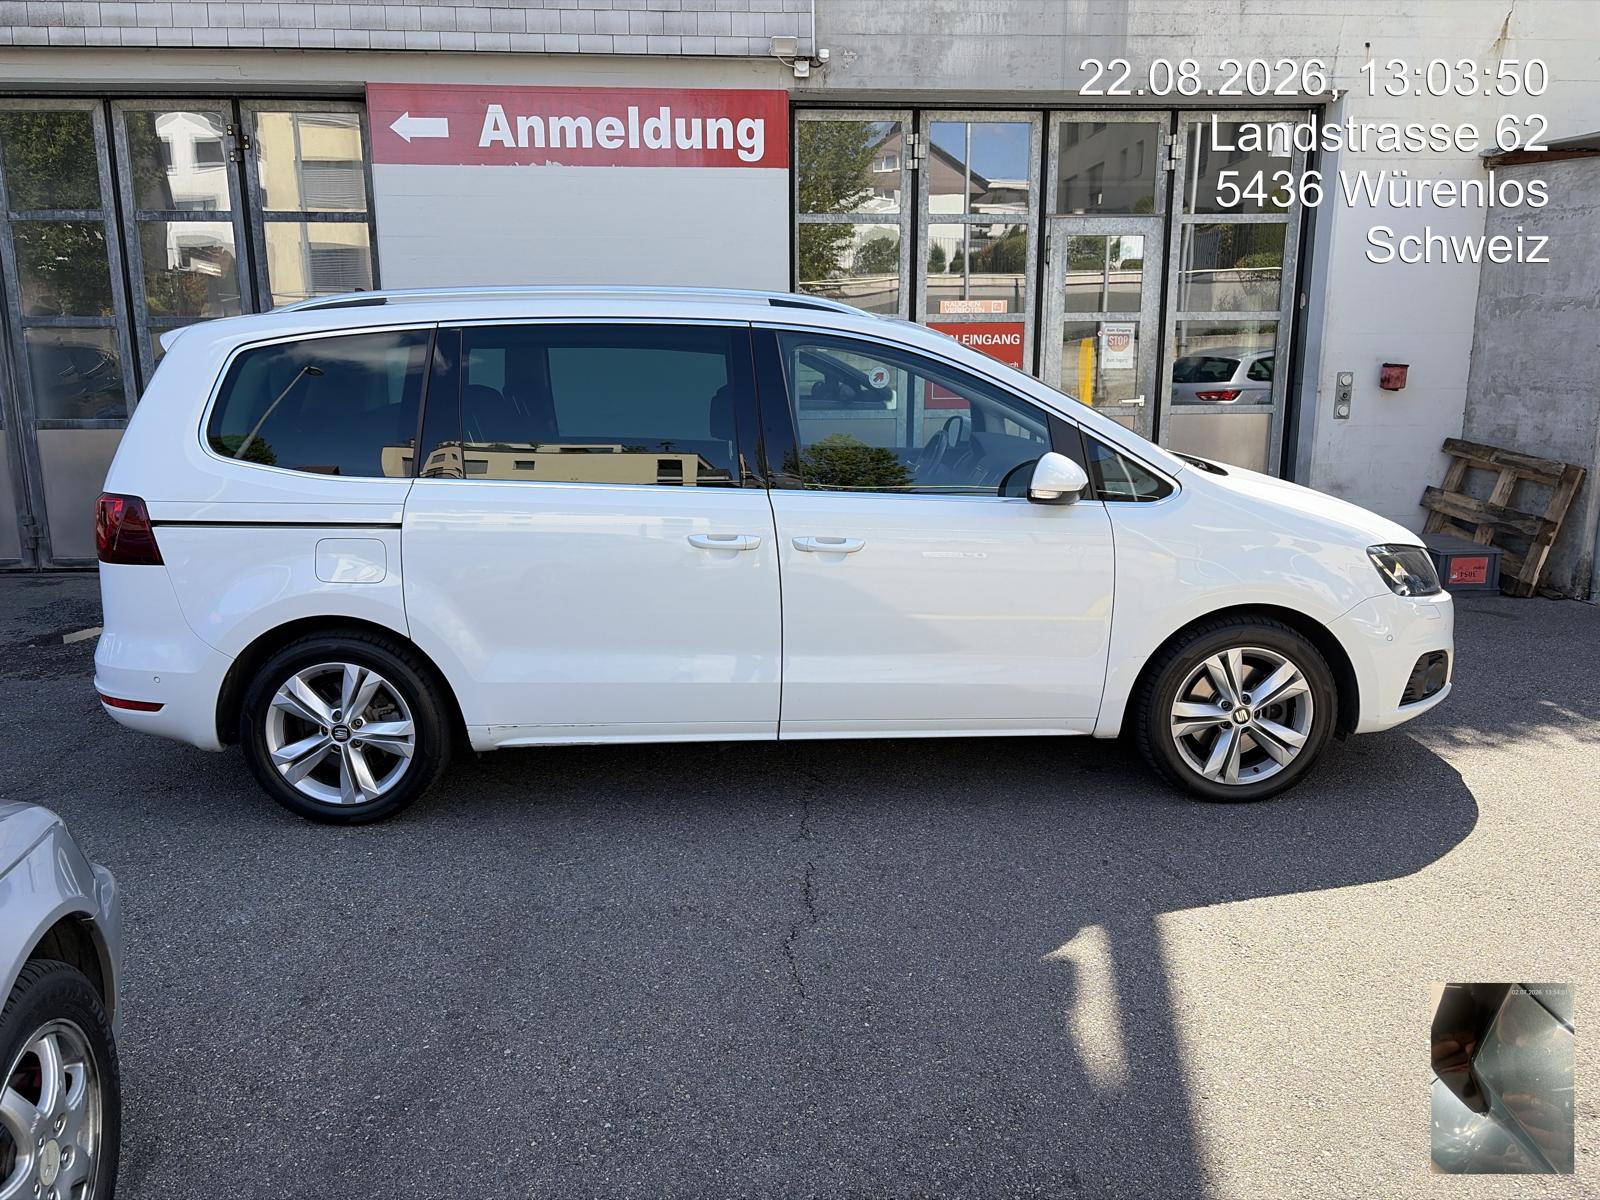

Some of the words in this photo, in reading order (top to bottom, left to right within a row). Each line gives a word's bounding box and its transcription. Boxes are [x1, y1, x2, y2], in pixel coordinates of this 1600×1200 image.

[478, 104, 765, 162] Anmeldung
[962, 333, 1021, 345] EINGANG
[1108, 335, 1130, 346] STOP
